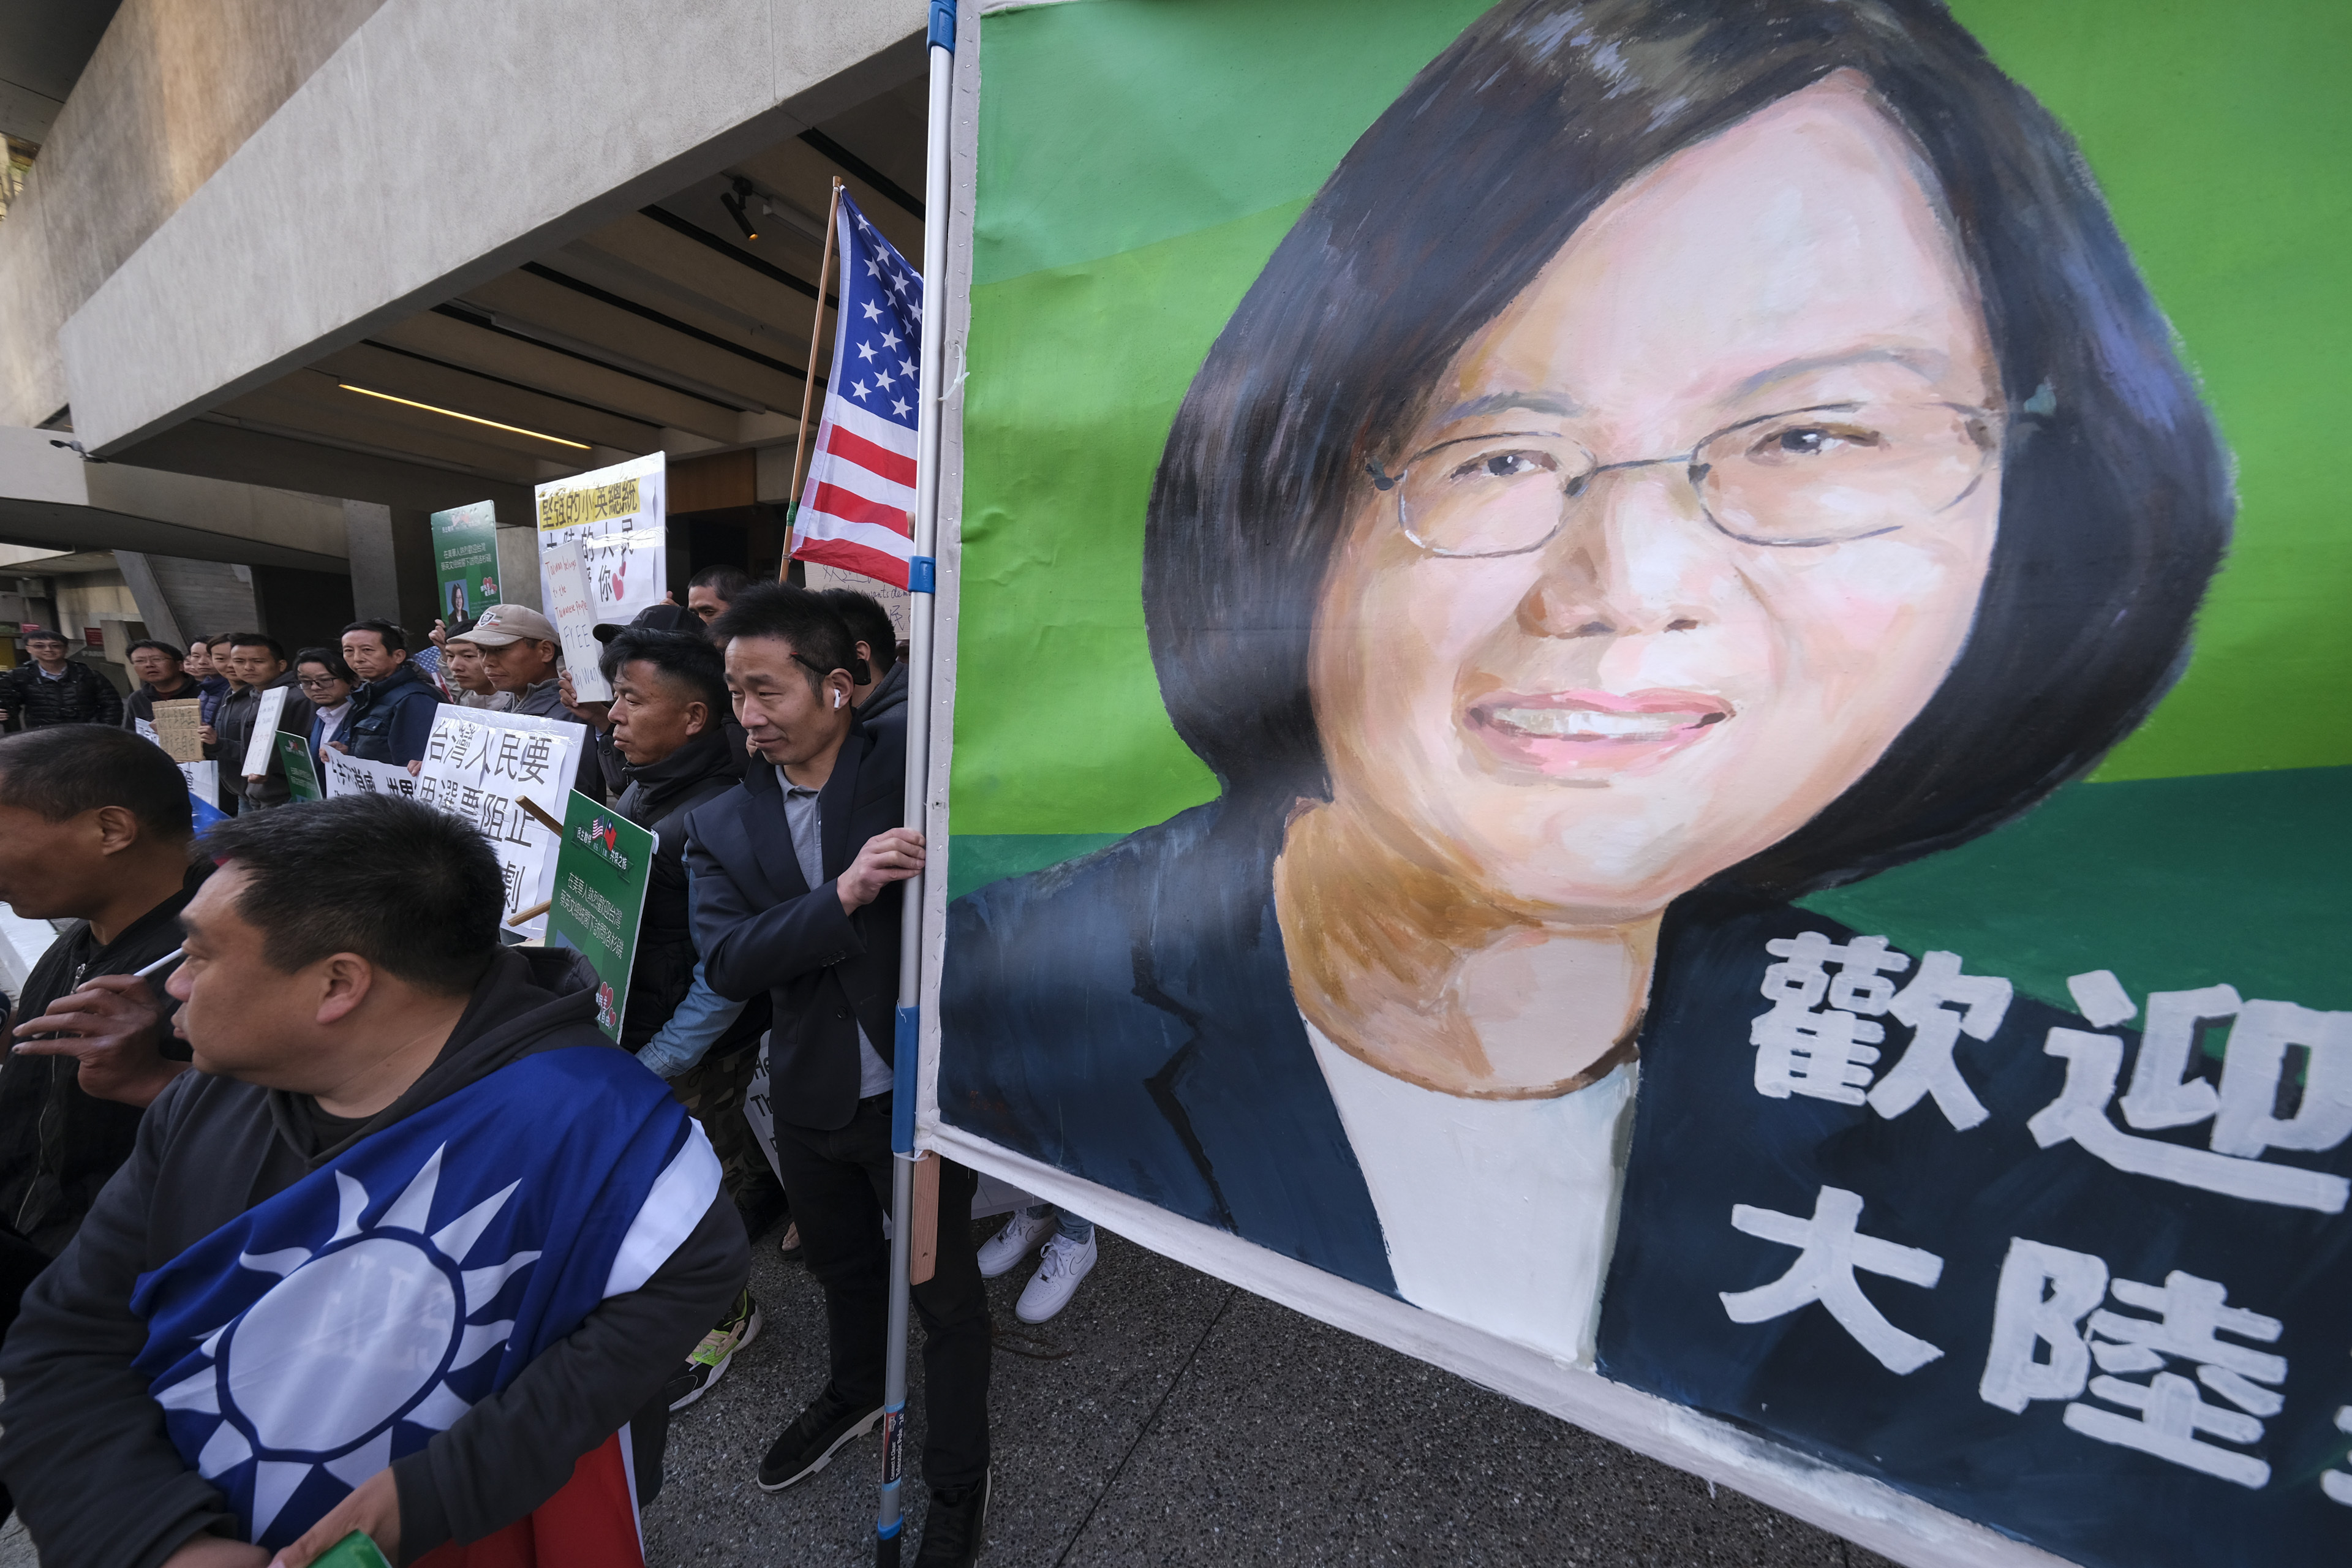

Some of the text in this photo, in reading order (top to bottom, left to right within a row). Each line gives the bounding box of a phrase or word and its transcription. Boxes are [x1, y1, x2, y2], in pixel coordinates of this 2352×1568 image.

[552, 584, 567, 598] to the
[429, 720, 552, 785] 台灣人民要
[385, 776, 418, 799] 世界
[1749, 930, 2352, 1215] 歡迎
[1719, 1184, 2352, 1506] 大陸
